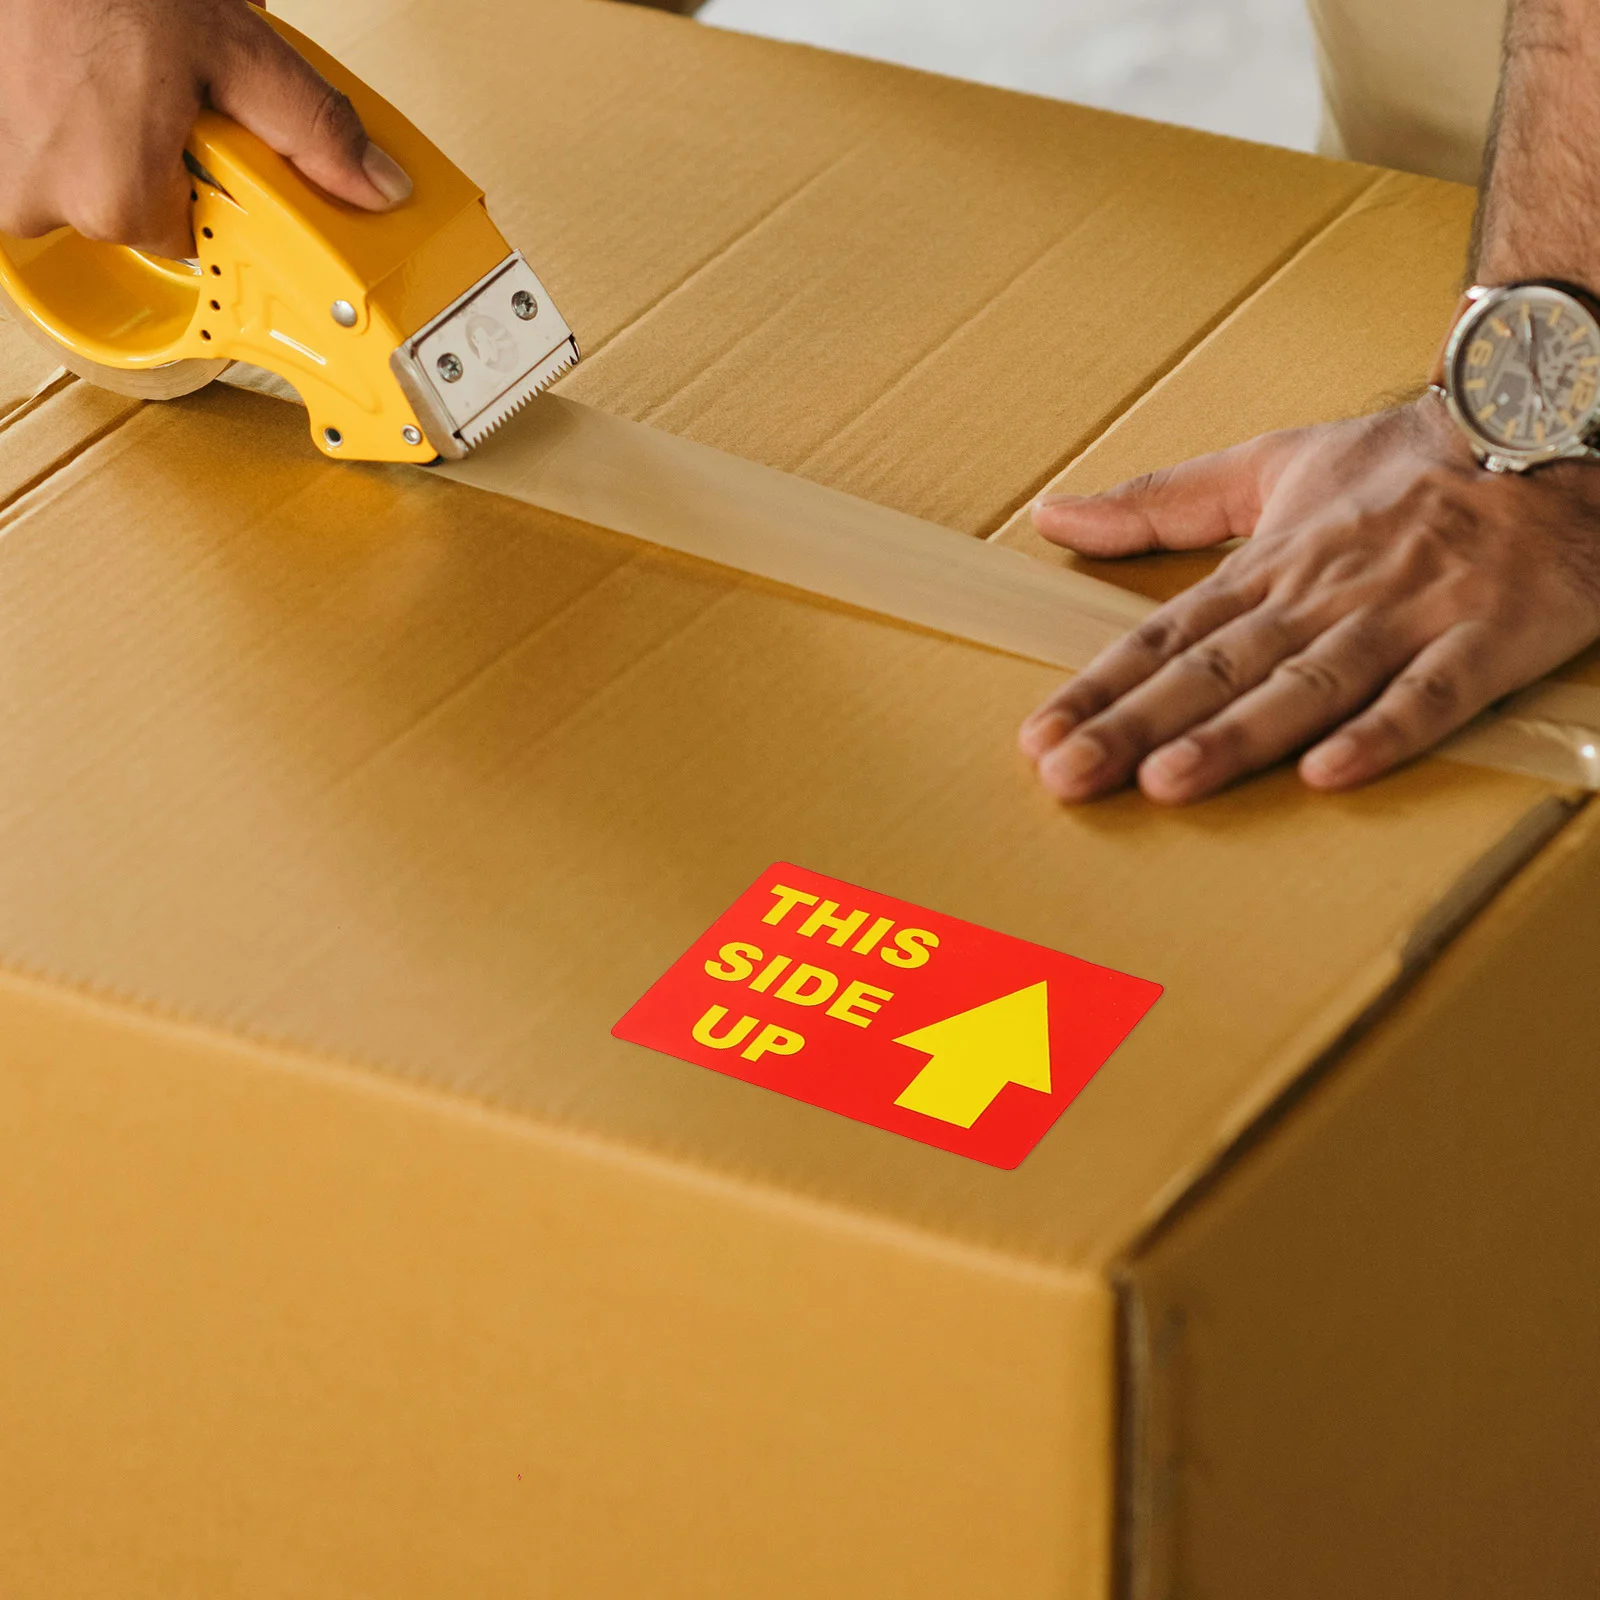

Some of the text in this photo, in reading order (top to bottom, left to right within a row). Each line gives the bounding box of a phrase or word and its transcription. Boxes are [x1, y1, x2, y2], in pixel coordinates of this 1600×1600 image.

[762, 884, 939, 968] THIS
[705, 942, 894, 1028] SIDE
[692, 1005, 805, 1061] UP
